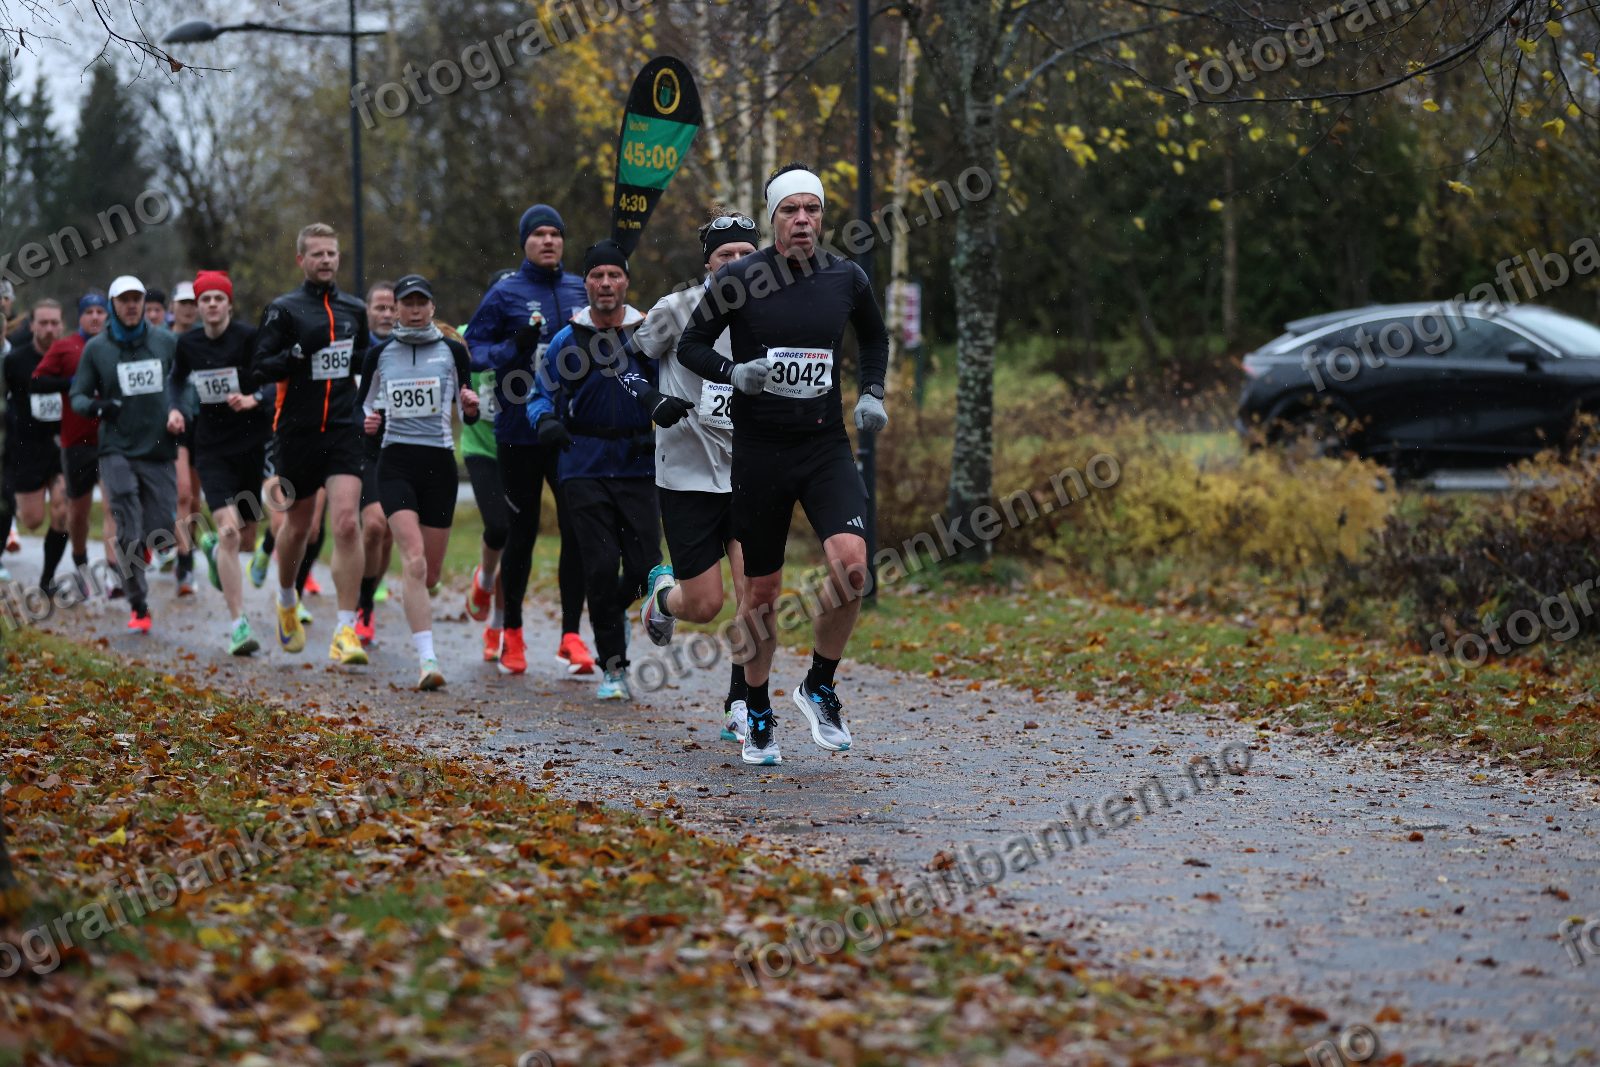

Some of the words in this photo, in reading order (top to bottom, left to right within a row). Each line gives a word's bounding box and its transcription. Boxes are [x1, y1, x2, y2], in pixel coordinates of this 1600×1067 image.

[624, 141, 678, 171] 45:00
[619, 193, 648, 212] 4:30
[322, 351, 349, 370] 385
[772, 351, 829, 359] NORGESTESTEN
[128, 369, 155, 388] 562
[771, 362, 826, 386] 3042
[204, 377, 230, 395] 165
[392, 387, 434, 408] 9361
